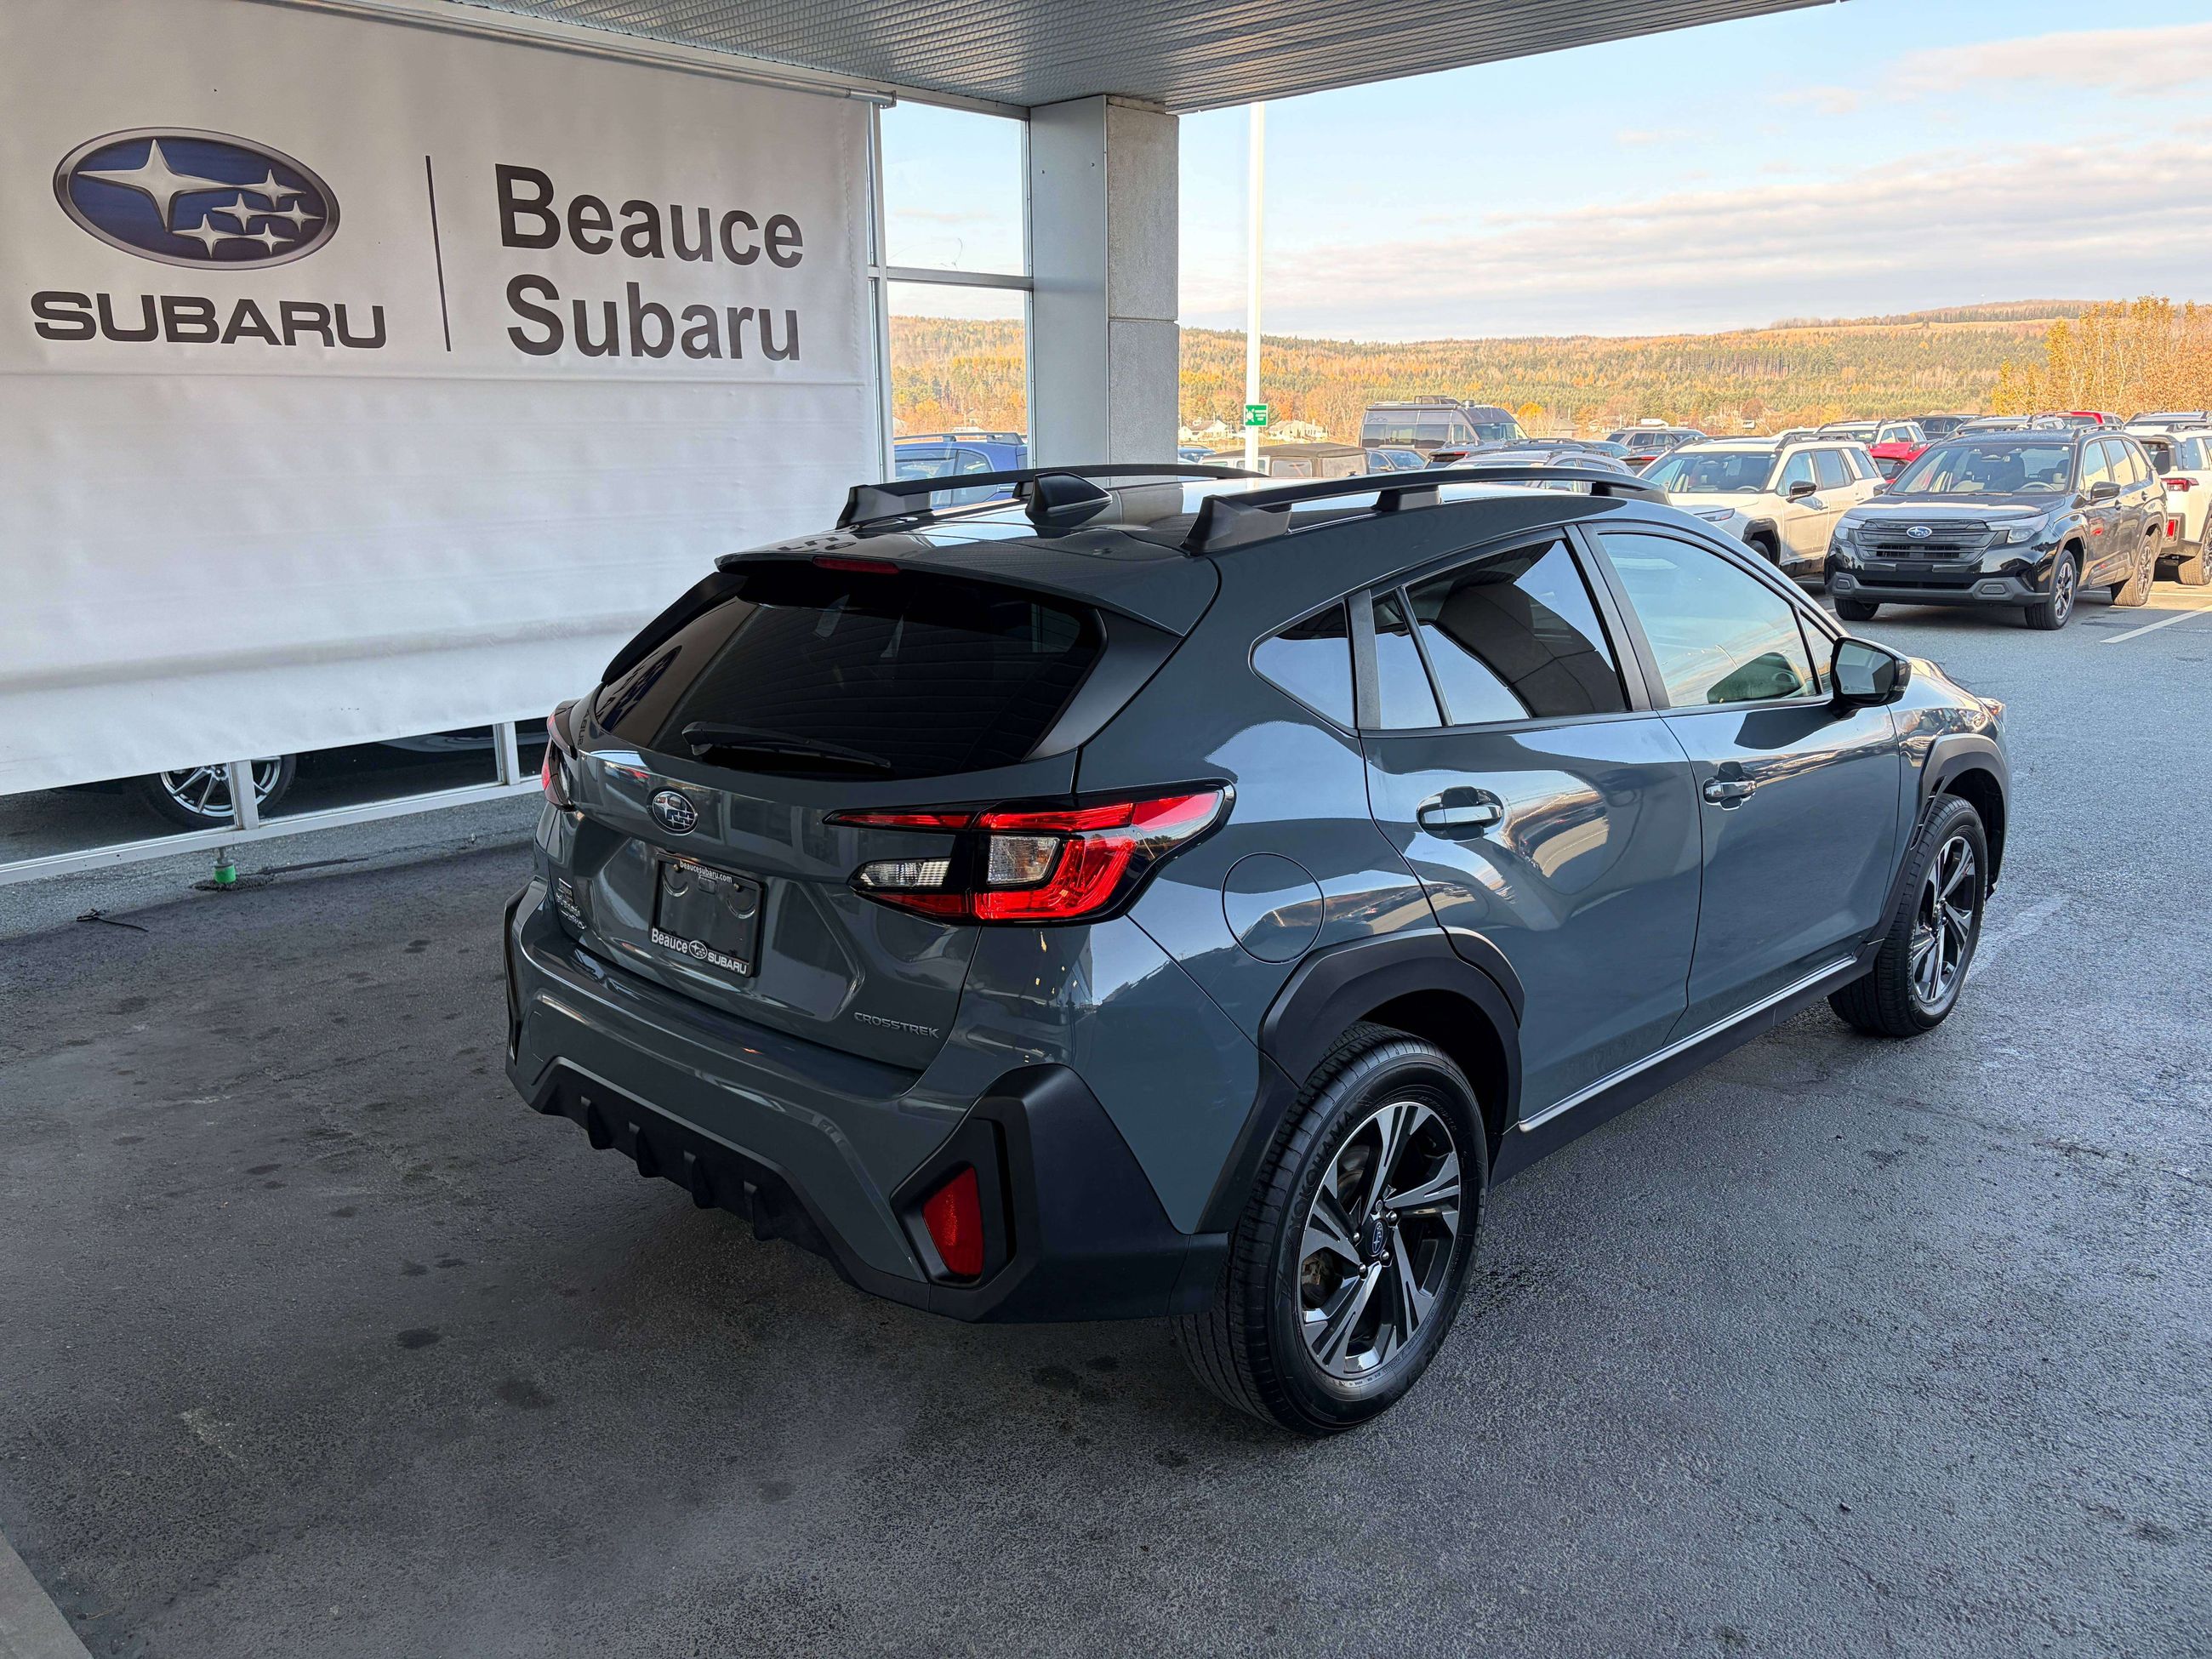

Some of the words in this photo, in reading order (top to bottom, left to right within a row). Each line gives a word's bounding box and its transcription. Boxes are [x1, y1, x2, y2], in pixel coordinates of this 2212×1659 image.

[494, 163, 804, 268] Beauce
[31, 291, 386, 349] SUBARU
[506, 274, 800, 360] Subaru
[680, 859, 733, 884] beaucesubaru.com
[651, 927, 688, 954] Beauce
[707, 953, 747, 975] SUBARU
[853, 1012, 939, 1039] CROSSTREK
[1287, 1109, 1354, 1236] YOKOHAMA
